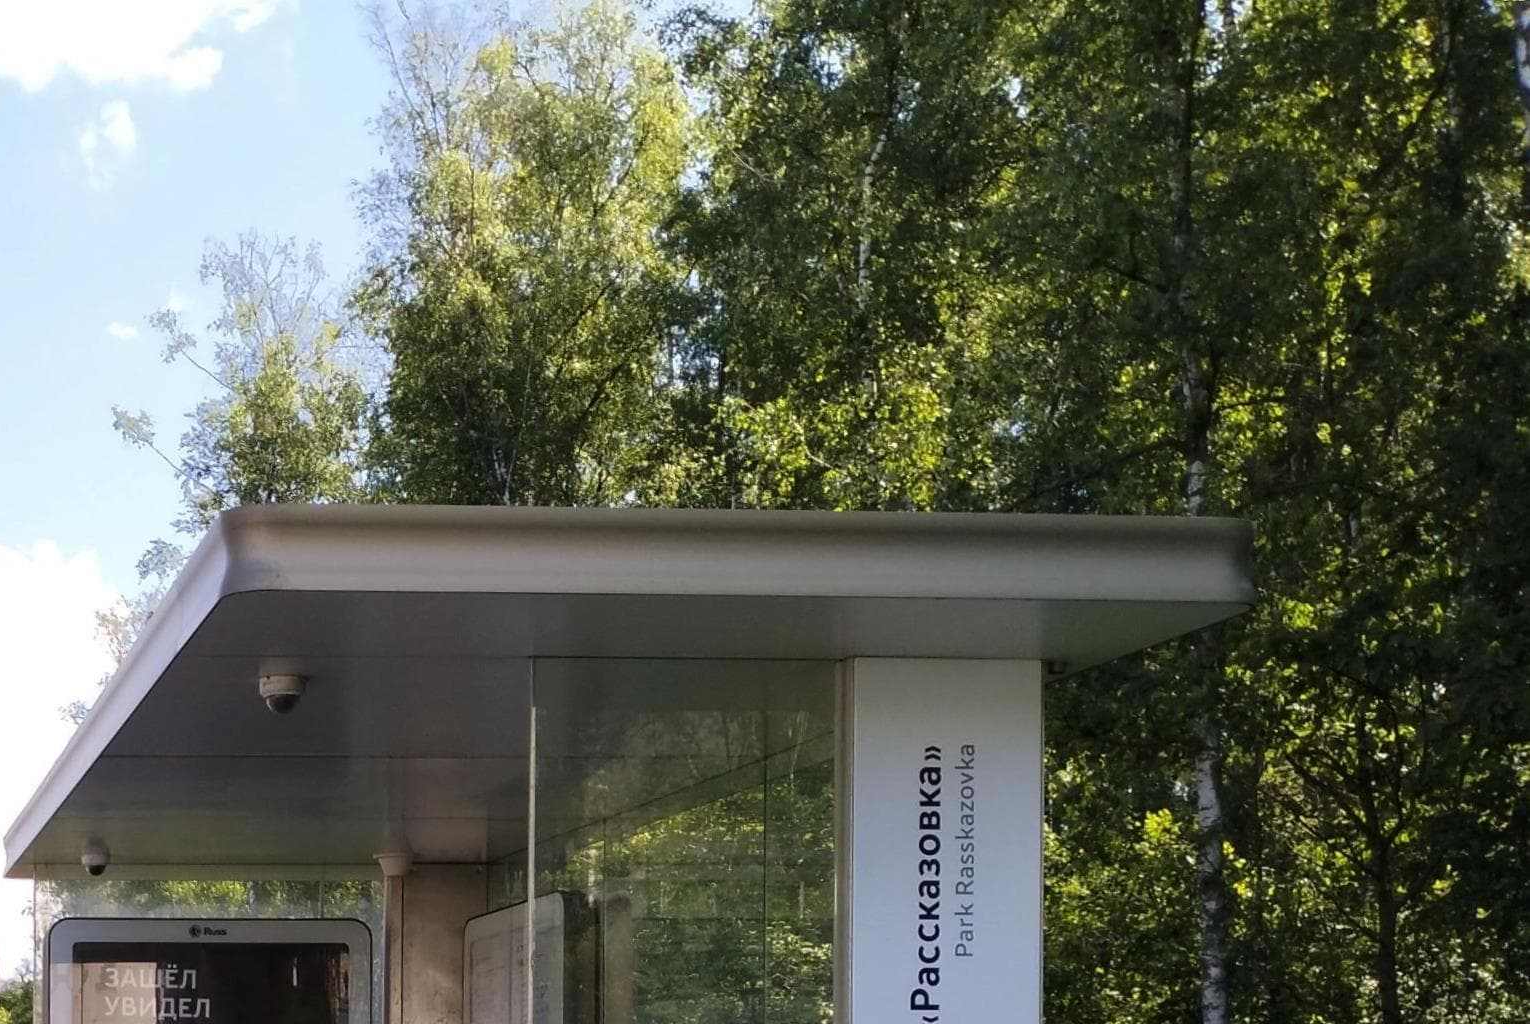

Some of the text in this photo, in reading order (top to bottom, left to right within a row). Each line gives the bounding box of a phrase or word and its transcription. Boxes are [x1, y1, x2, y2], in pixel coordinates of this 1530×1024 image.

[954, 743, 976, 957] Park Rasskazovka
[105, 963, 197, 990] ЗАШЁЛ
[104, 996, 211, 1021] УВИДЕЛ
